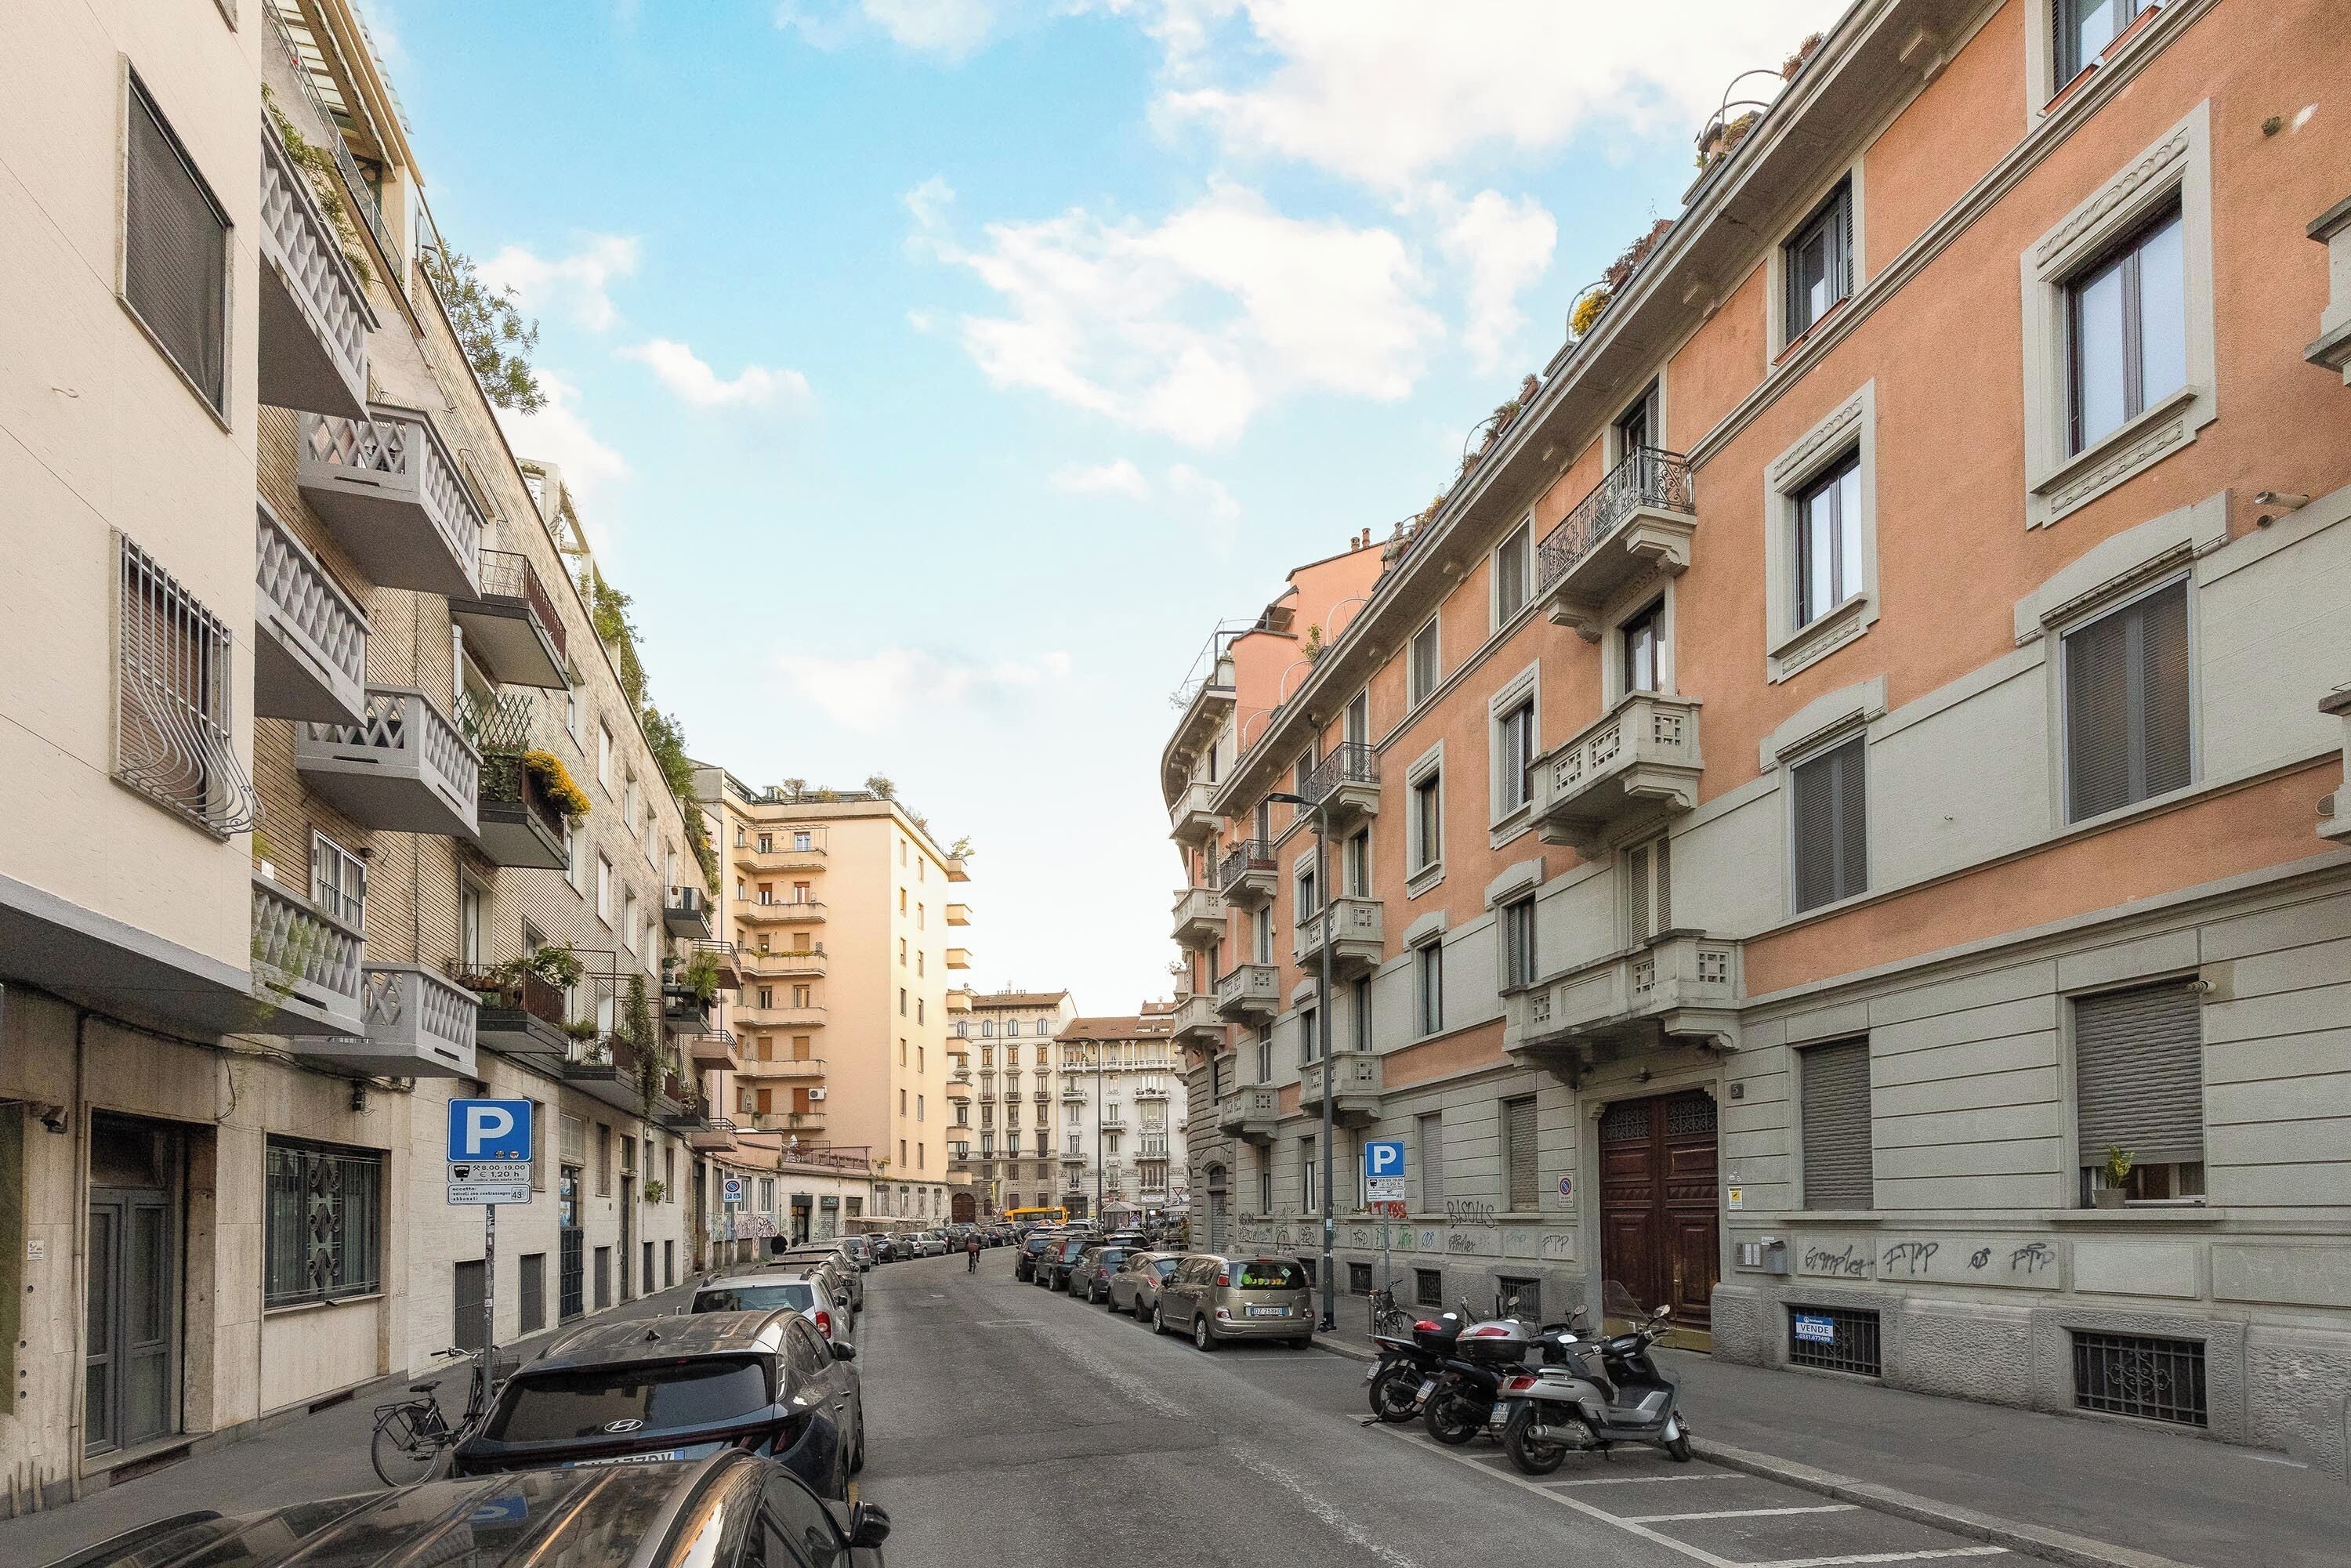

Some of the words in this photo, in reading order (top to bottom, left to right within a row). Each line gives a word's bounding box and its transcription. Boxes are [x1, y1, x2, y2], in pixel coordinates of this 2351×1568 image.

[466, 1106, 514, 1153] P
[1374, 1146, 1396, 1173] P
[1800, 1324, 1829, 1334] VENDE
